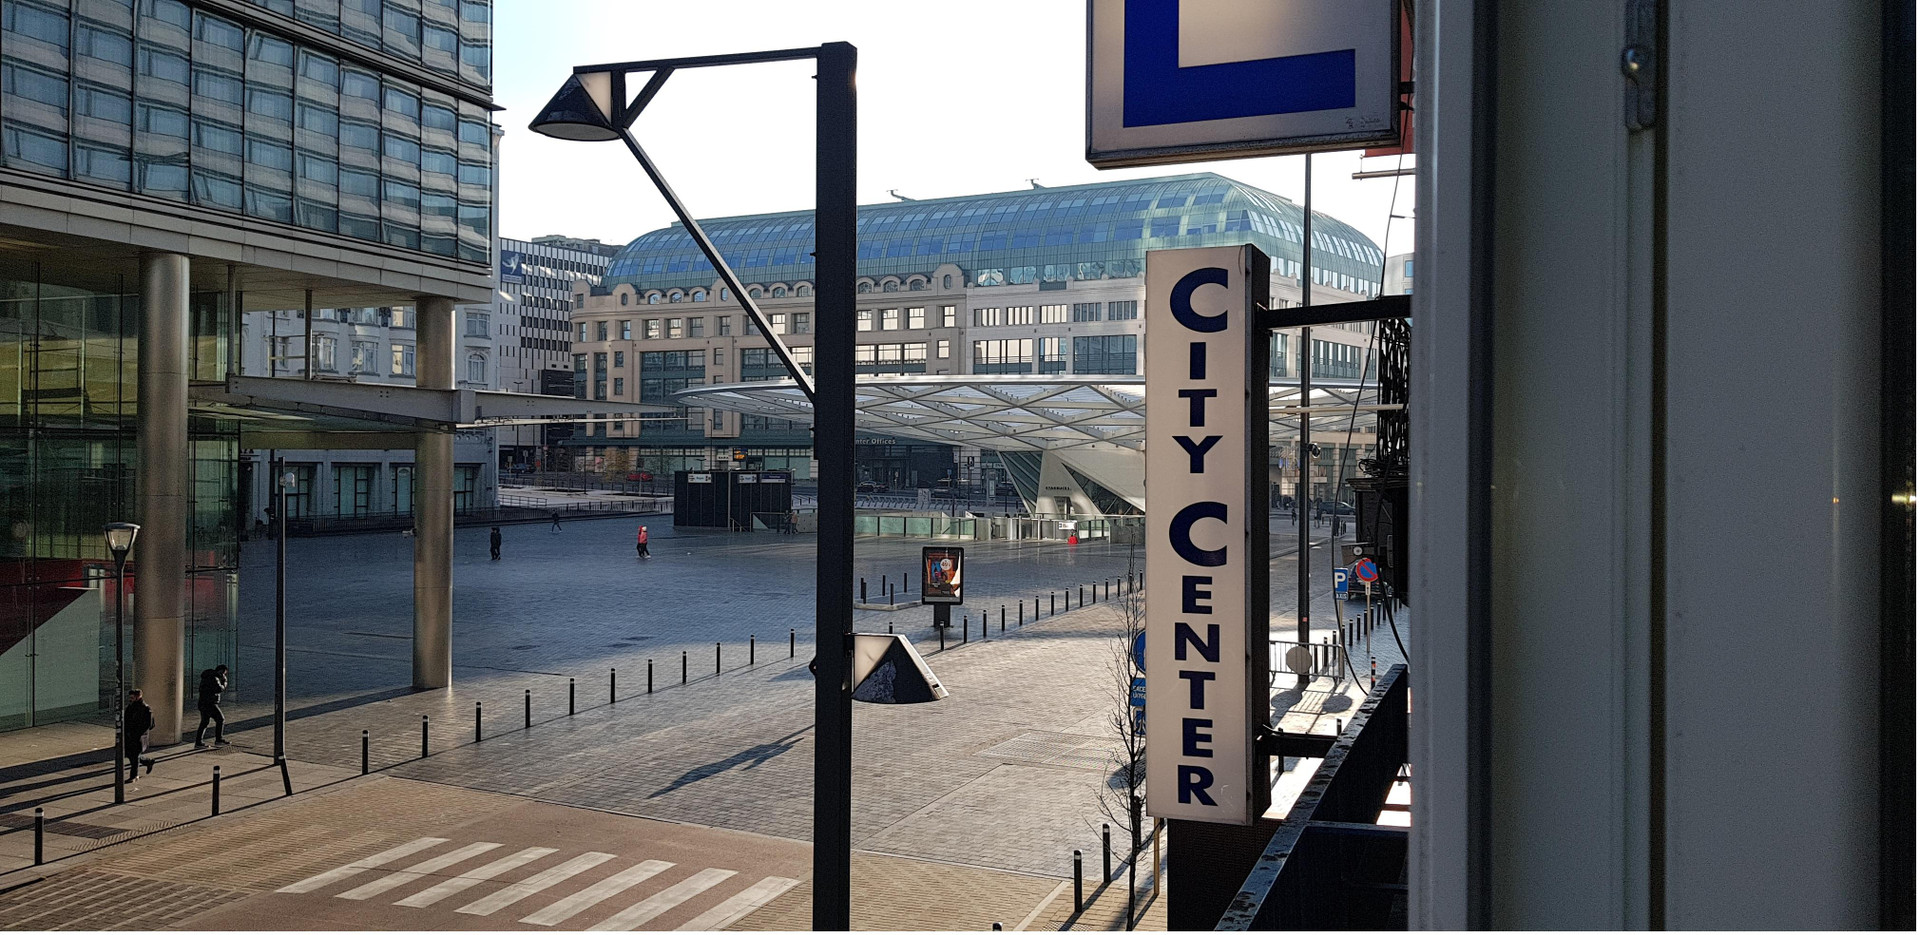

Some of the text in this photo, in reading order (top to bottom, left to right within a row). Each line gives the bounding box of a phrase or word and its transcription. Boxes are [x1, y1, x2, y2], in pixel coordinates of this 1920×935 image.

[871, 437, 896, 445] Offices
[1168, 266, 1229, 807] CITY CENTER
[1334, 572, 1346, 589] P
